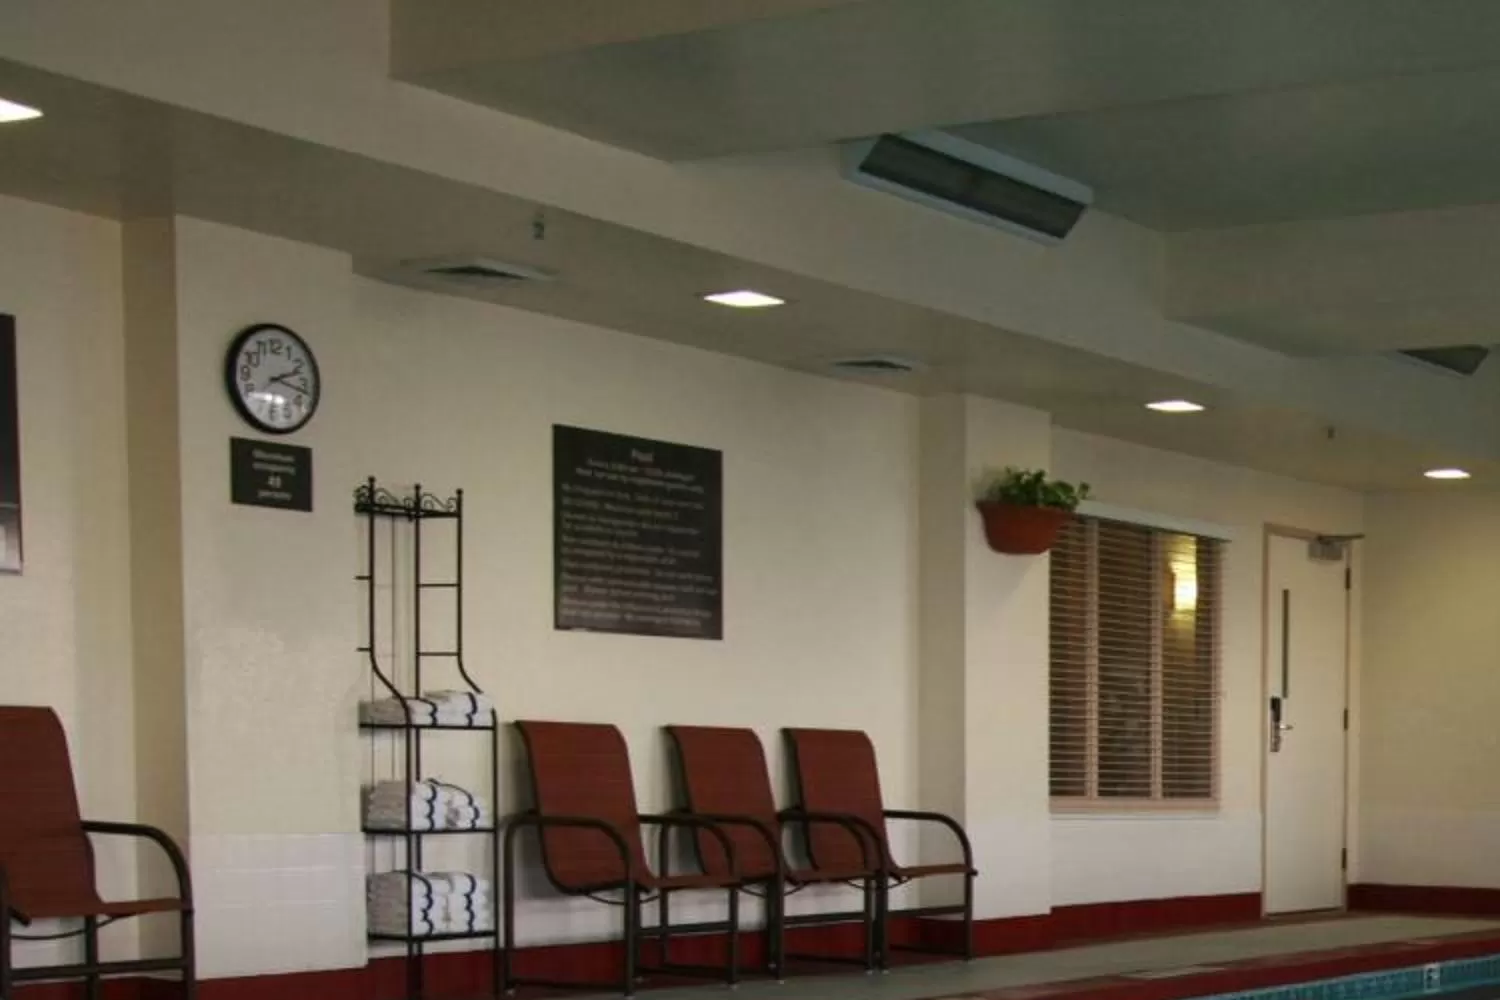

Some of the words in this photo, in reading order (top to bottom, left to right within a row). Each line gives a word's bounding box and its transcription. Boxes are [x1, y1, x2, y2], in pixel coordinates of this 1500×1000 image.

[257, 340, 266, 355] 11
[268, 338, 283, 355] 12
[285, 345, 293, 360] 1
[244, 351, 259, 368] 10
[241, 366, 251, 380] 9
